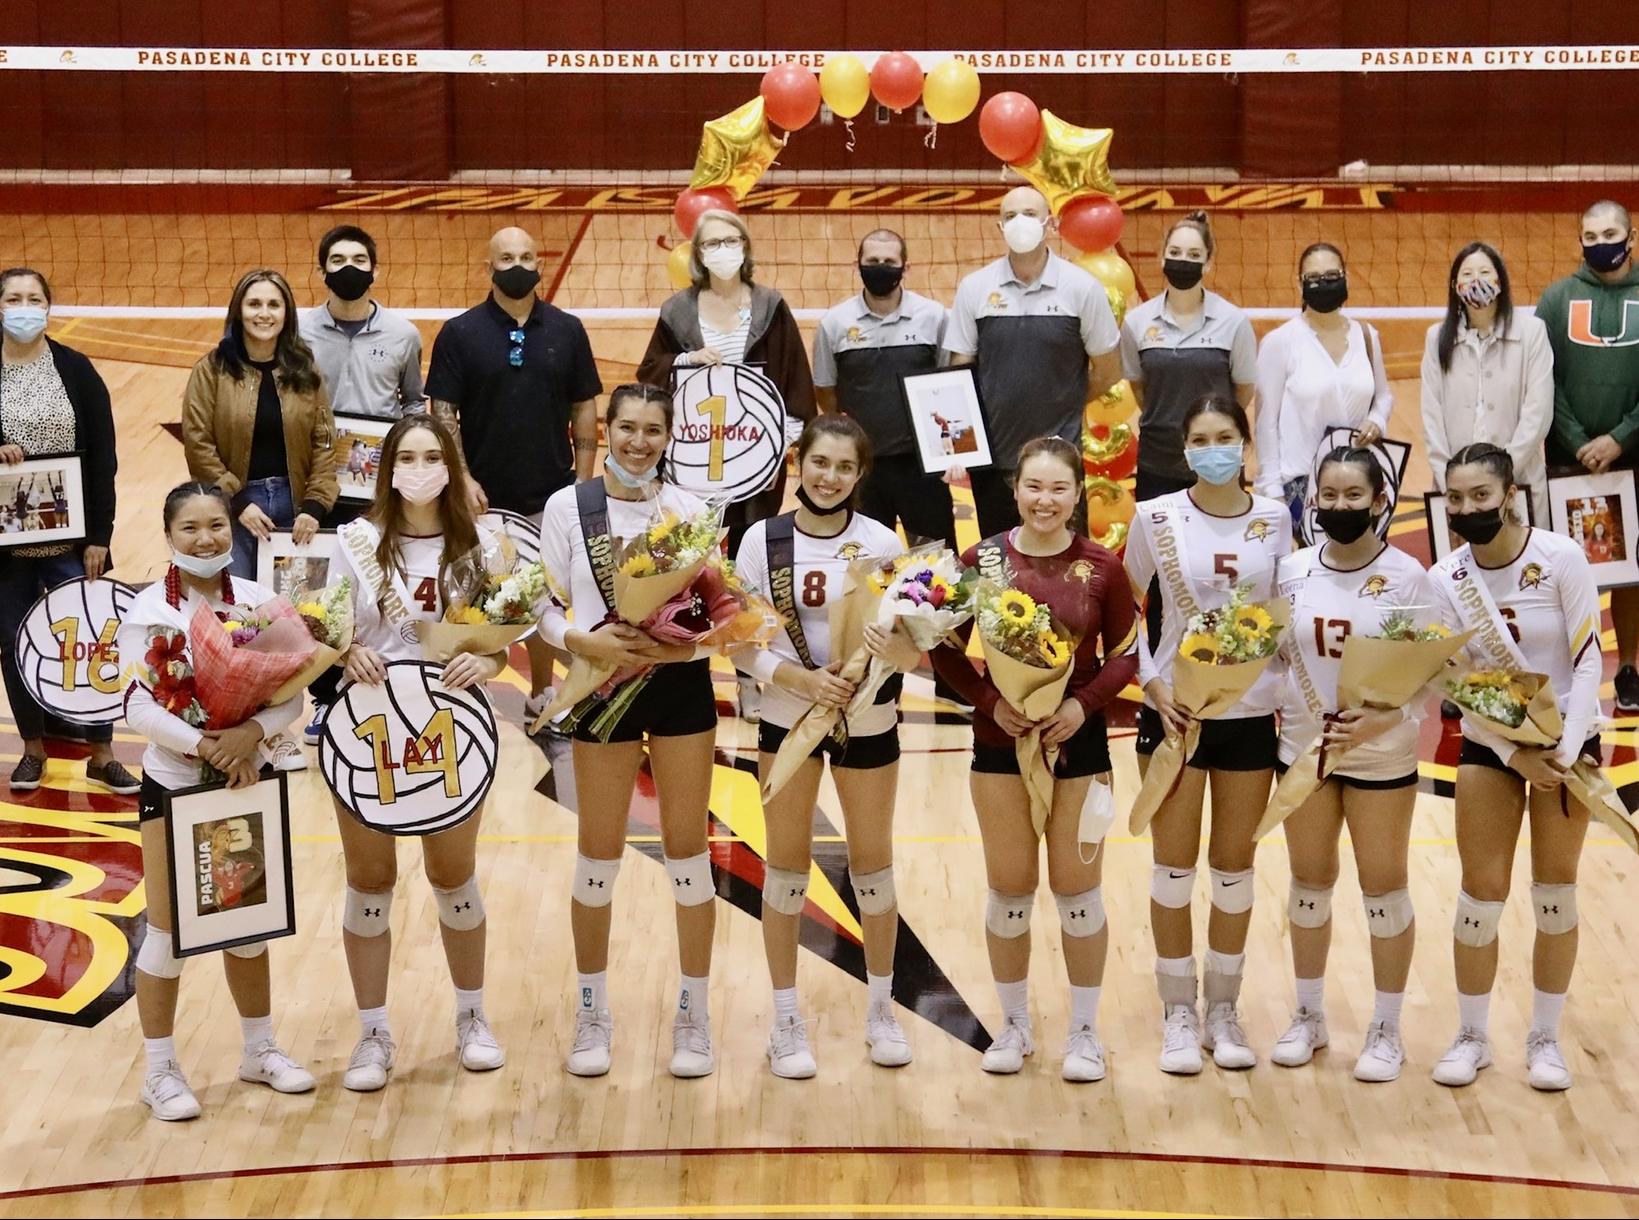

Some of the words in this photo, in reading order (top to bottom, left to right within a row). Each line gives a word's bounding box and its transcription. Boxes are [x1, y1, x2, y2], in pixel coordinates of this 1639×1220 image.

[137, 51, 251, 66] PASADENA
[261, 52, 311, 66] CITY
[321, 53, 418, 67] COLLEGE
[547, 53, 659, 68] PASADENA
[669, 53, 719, 68] CITY
[728, 53, 825, 68] COLLEGE
[1076, 53, 1125, 68] CITY
[1135, 52, 1232, 67] COLLEGE
[1361, 51, 1473, 66] PASADENA
[1484, 50, 1534, 65] CITY
[1544, 49, 1639, 64] COLLEGE
[1568, 299, 1639, 347] U
[680, 423, 760, 442] YOSHIOKA
[696, 395, 727, 481] 1
[1152, 511, 1168, 524] 5
[802, 570, 827, 608] 8
[1152, 525, 1202, 620] SOPHOMOR
[1214, 553, 1239, 589] 5
[1451, 567, 1468, 581] 6
[414, 576, 437, 612] 4
[1313, 616, 1352, 659] 13
[352, 707, 462, 805] 14
[381, 732, 443, 769] LAY
[226, 817, 253, 853] 3
[198, 840, 214, 905] PASCUA
